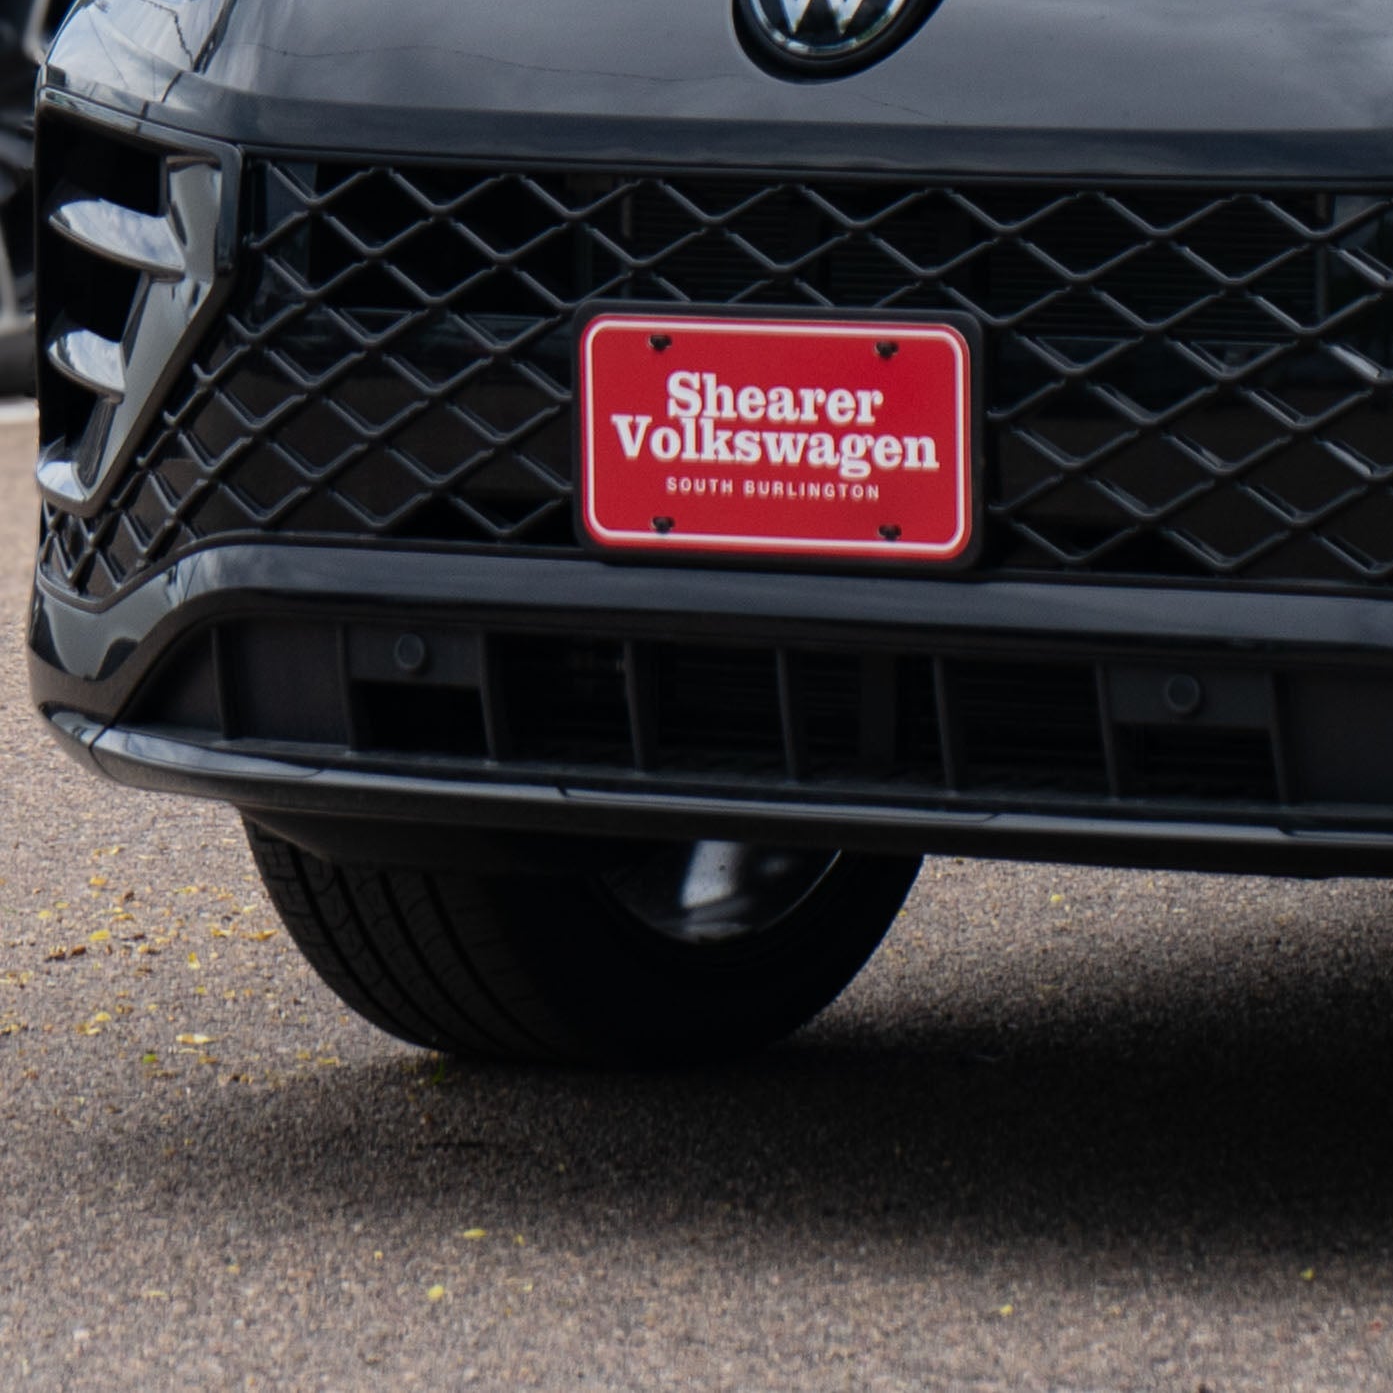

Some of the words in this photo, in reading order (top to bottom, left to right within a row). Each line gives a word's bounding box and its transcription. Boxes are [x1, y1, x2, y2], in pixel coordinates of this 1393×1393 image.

[666, 370, 884, 424] Shearer
[610, 413, 940, 478] Volkswagen
[665, 476, 734, 496] SOUTH
[743, 479, 881, 502] BURLINGTON
